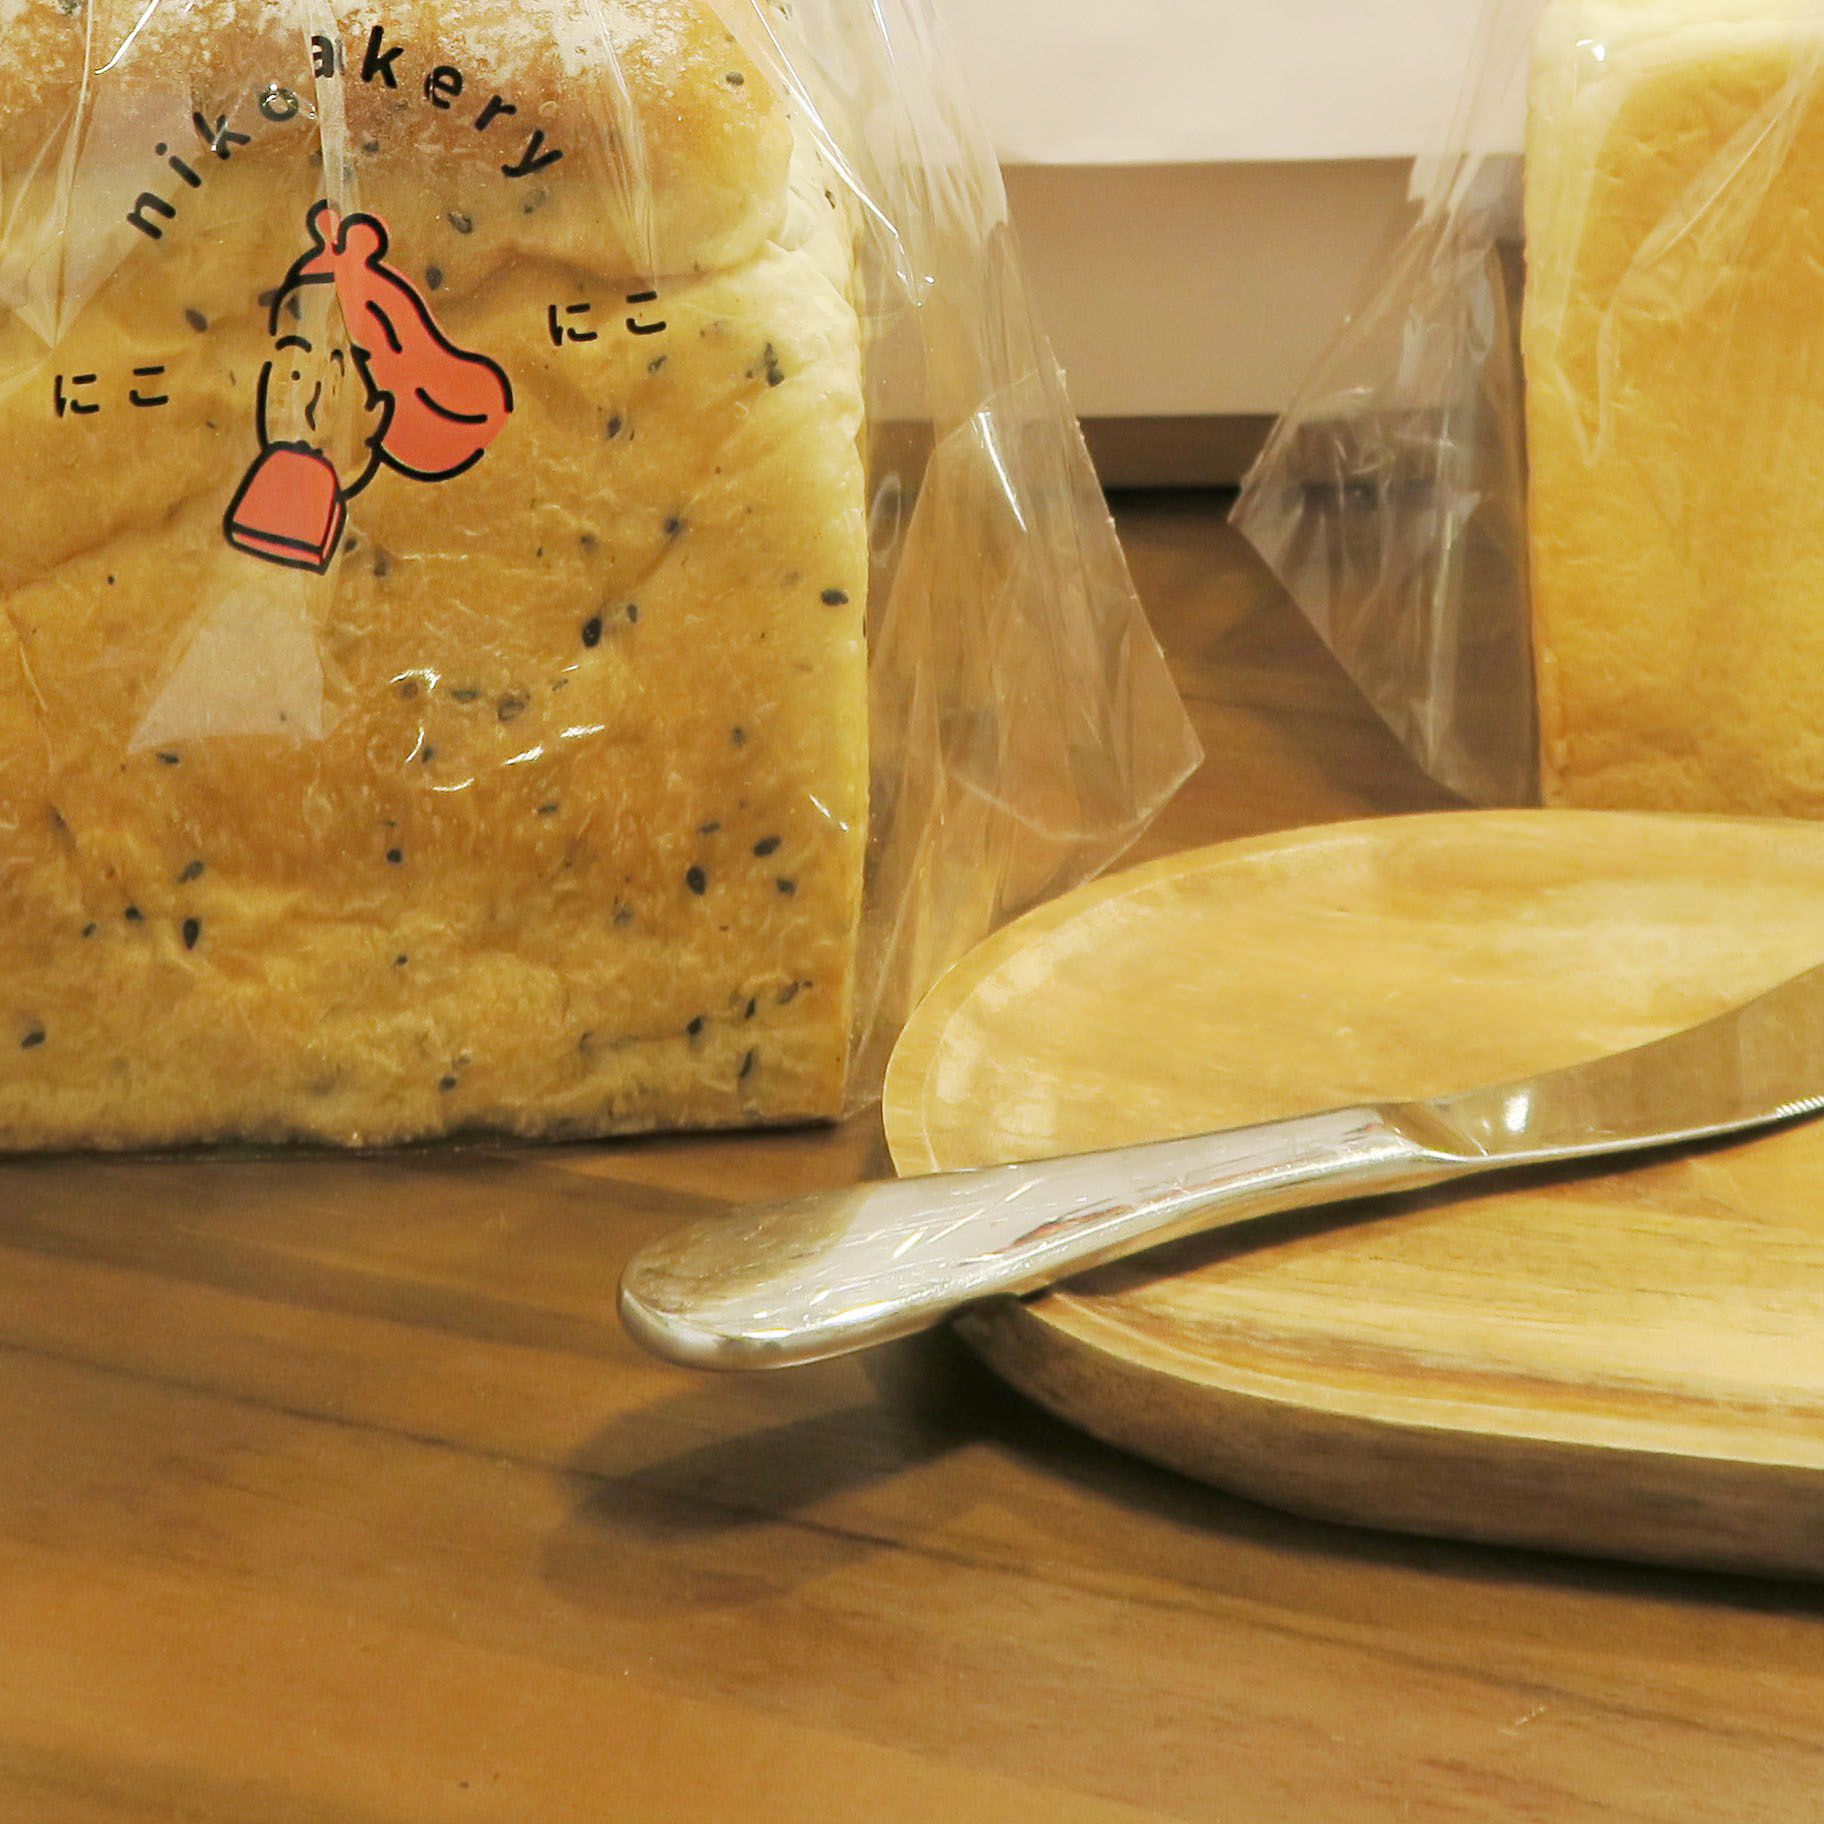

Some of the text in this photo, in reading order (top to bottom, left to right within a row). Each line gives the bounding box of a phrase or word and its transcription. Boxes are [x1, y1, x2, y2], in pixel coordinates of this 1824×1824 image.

[126, 24, 564, 240] niko akery
[547, 290, 668, 347] にこ
[54, 366, 170, 418] にこ
